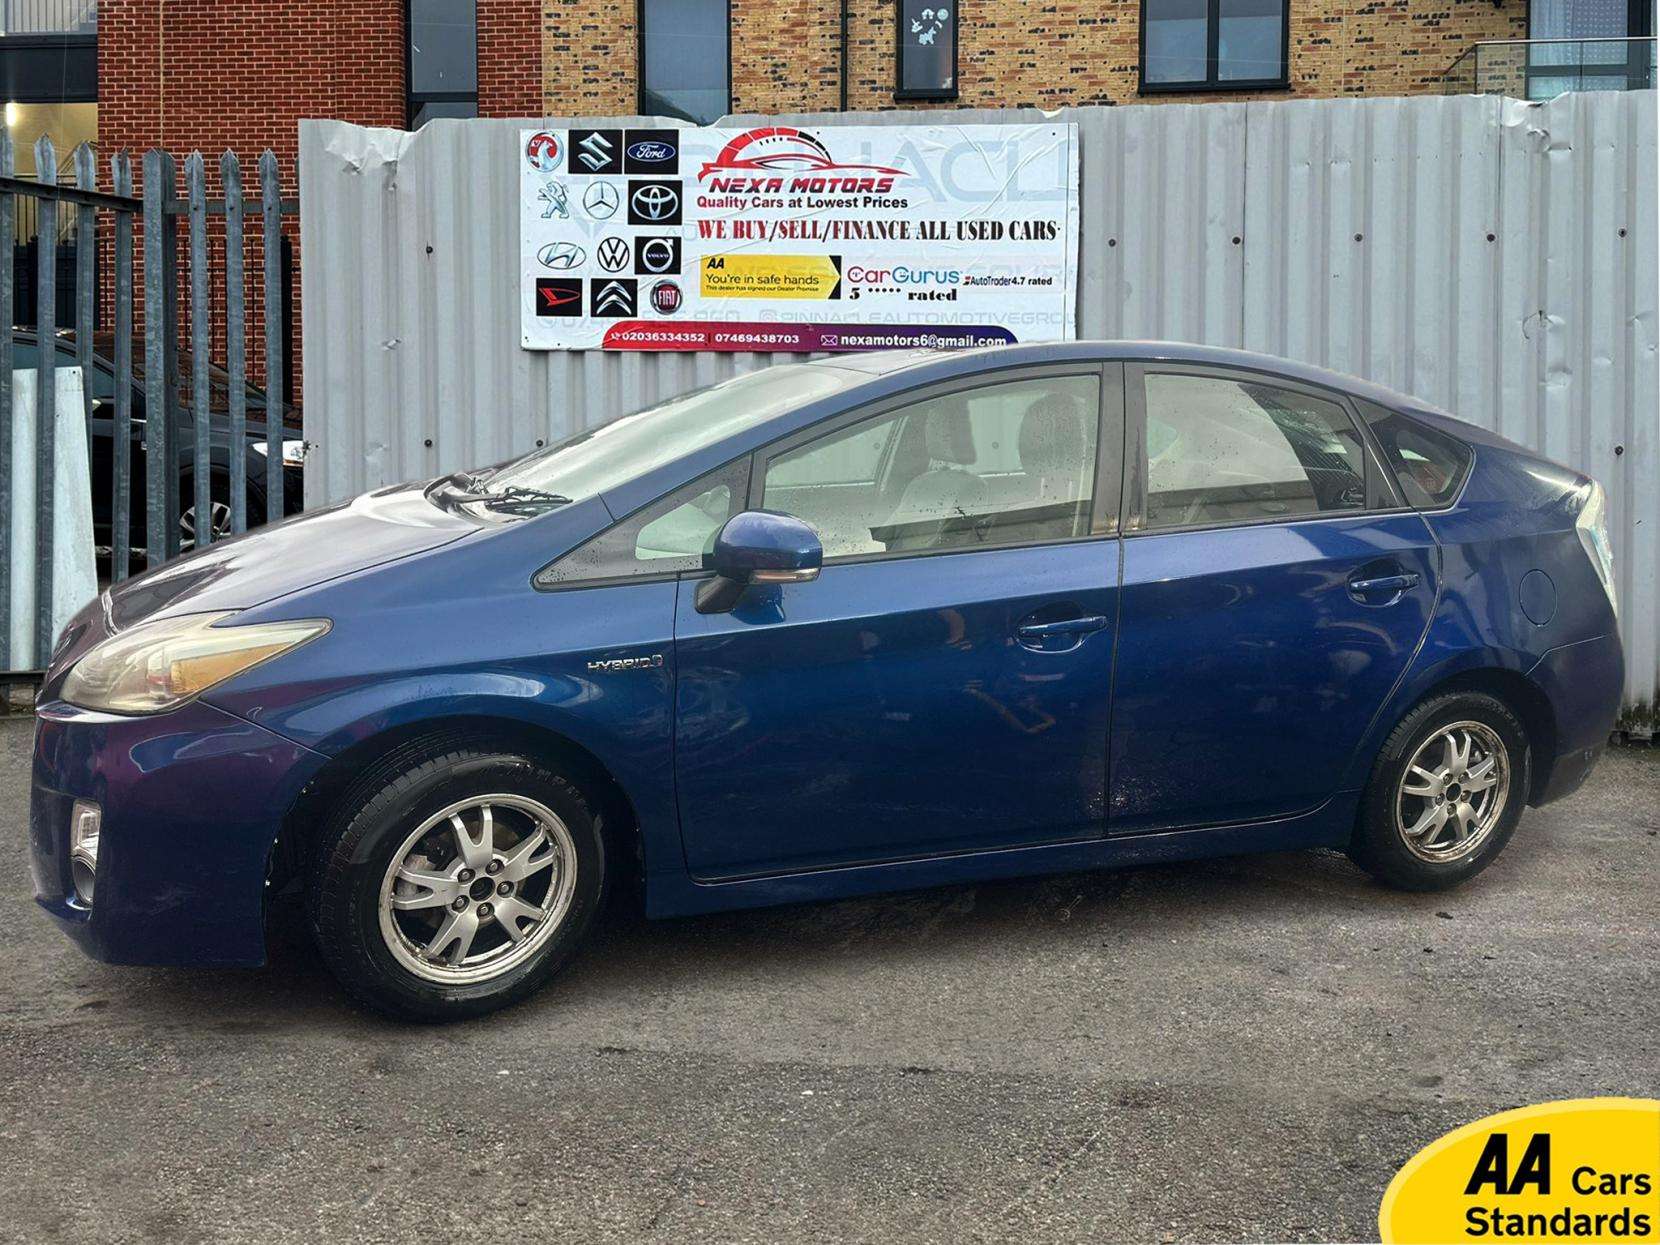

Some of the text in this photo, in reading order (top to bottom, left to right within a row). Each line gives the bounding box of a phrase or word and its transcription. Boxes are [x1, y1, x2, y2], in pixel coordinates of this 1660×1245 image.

[636, 144, 667, 158] Ford
[709, 178, 894, 193] NEXA MOTORS
[697, 196, 908, 210] Quality Cars at Lowest Prices
[697, 220, 727, 240] WE
[917, 220, 950, 240] ALL
[956, 220, 1004, 240] USED
[707, 258, 724, 269] AA
[706, 274, 819, 285] You're in safe hands
[847, 266, 960, 284] CarGurus
[1028, 277, 1053, 286] rated
[658, 291, 677, 306] FIAT
[849, 288, 957, 301] 5 rated
[622, 333, 800, 343] 02036334352 07469438703
[587, 657, 651, 671] HYBRID
